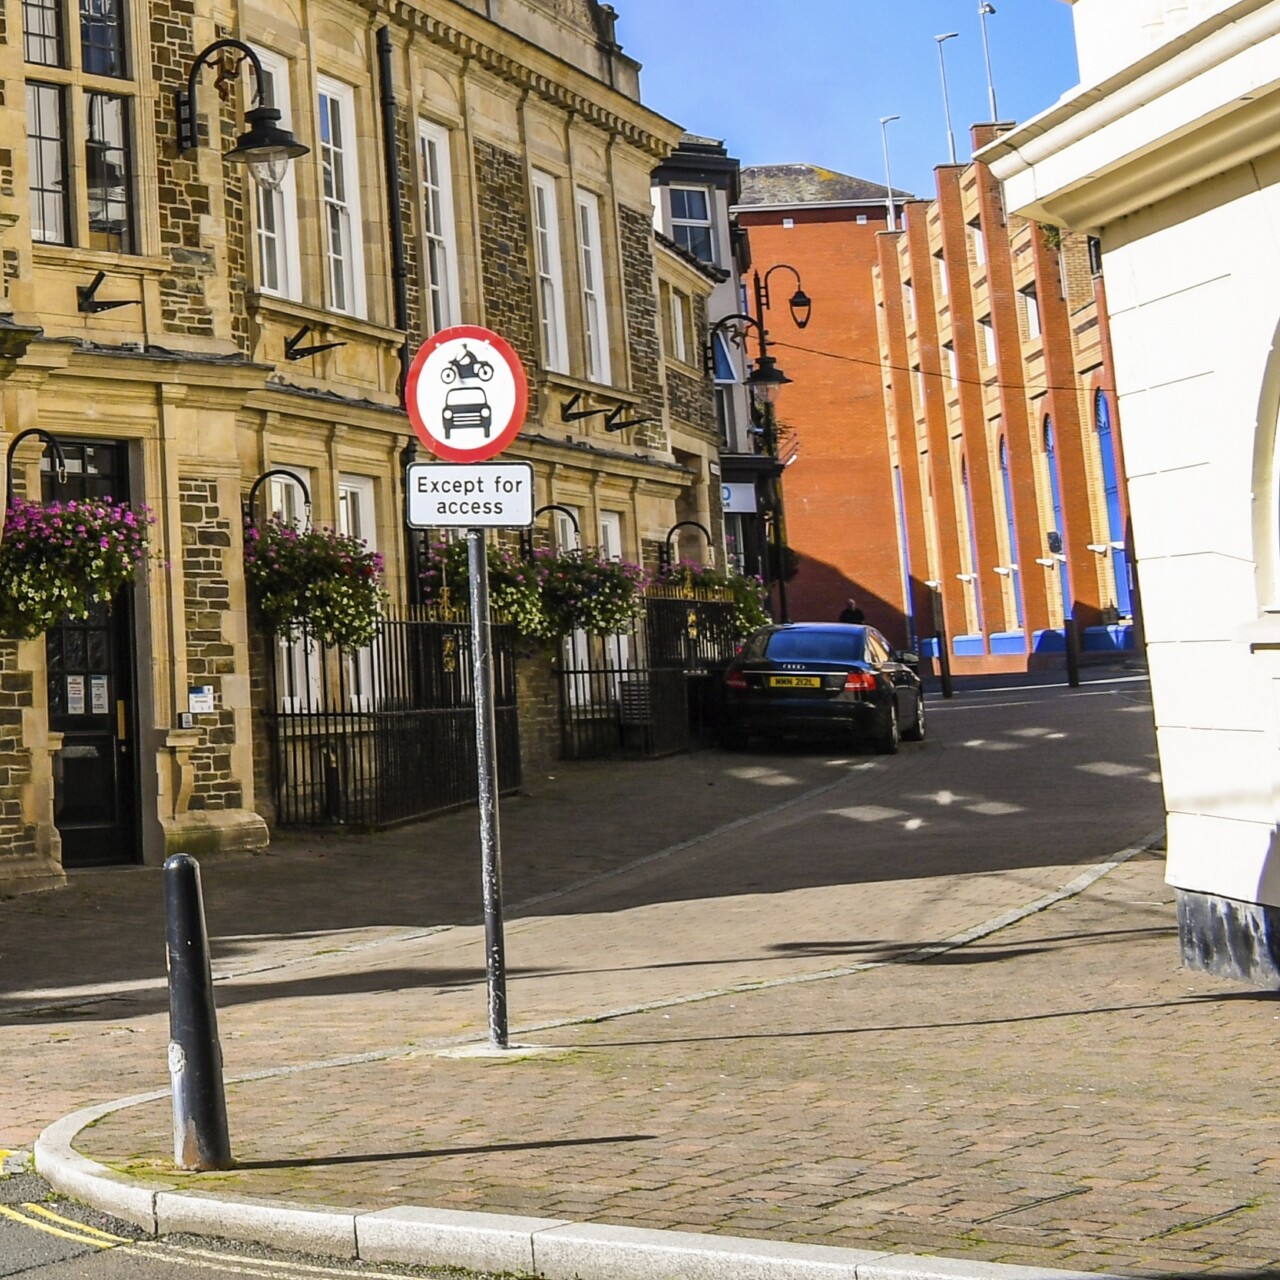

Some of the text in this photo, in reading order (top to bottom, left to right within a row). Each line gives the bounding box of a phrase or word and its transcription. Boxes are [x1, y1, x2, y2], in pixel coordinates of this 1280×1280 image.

[417, 476, 522, 496] Except for
[436, 500, 503, 515] access
